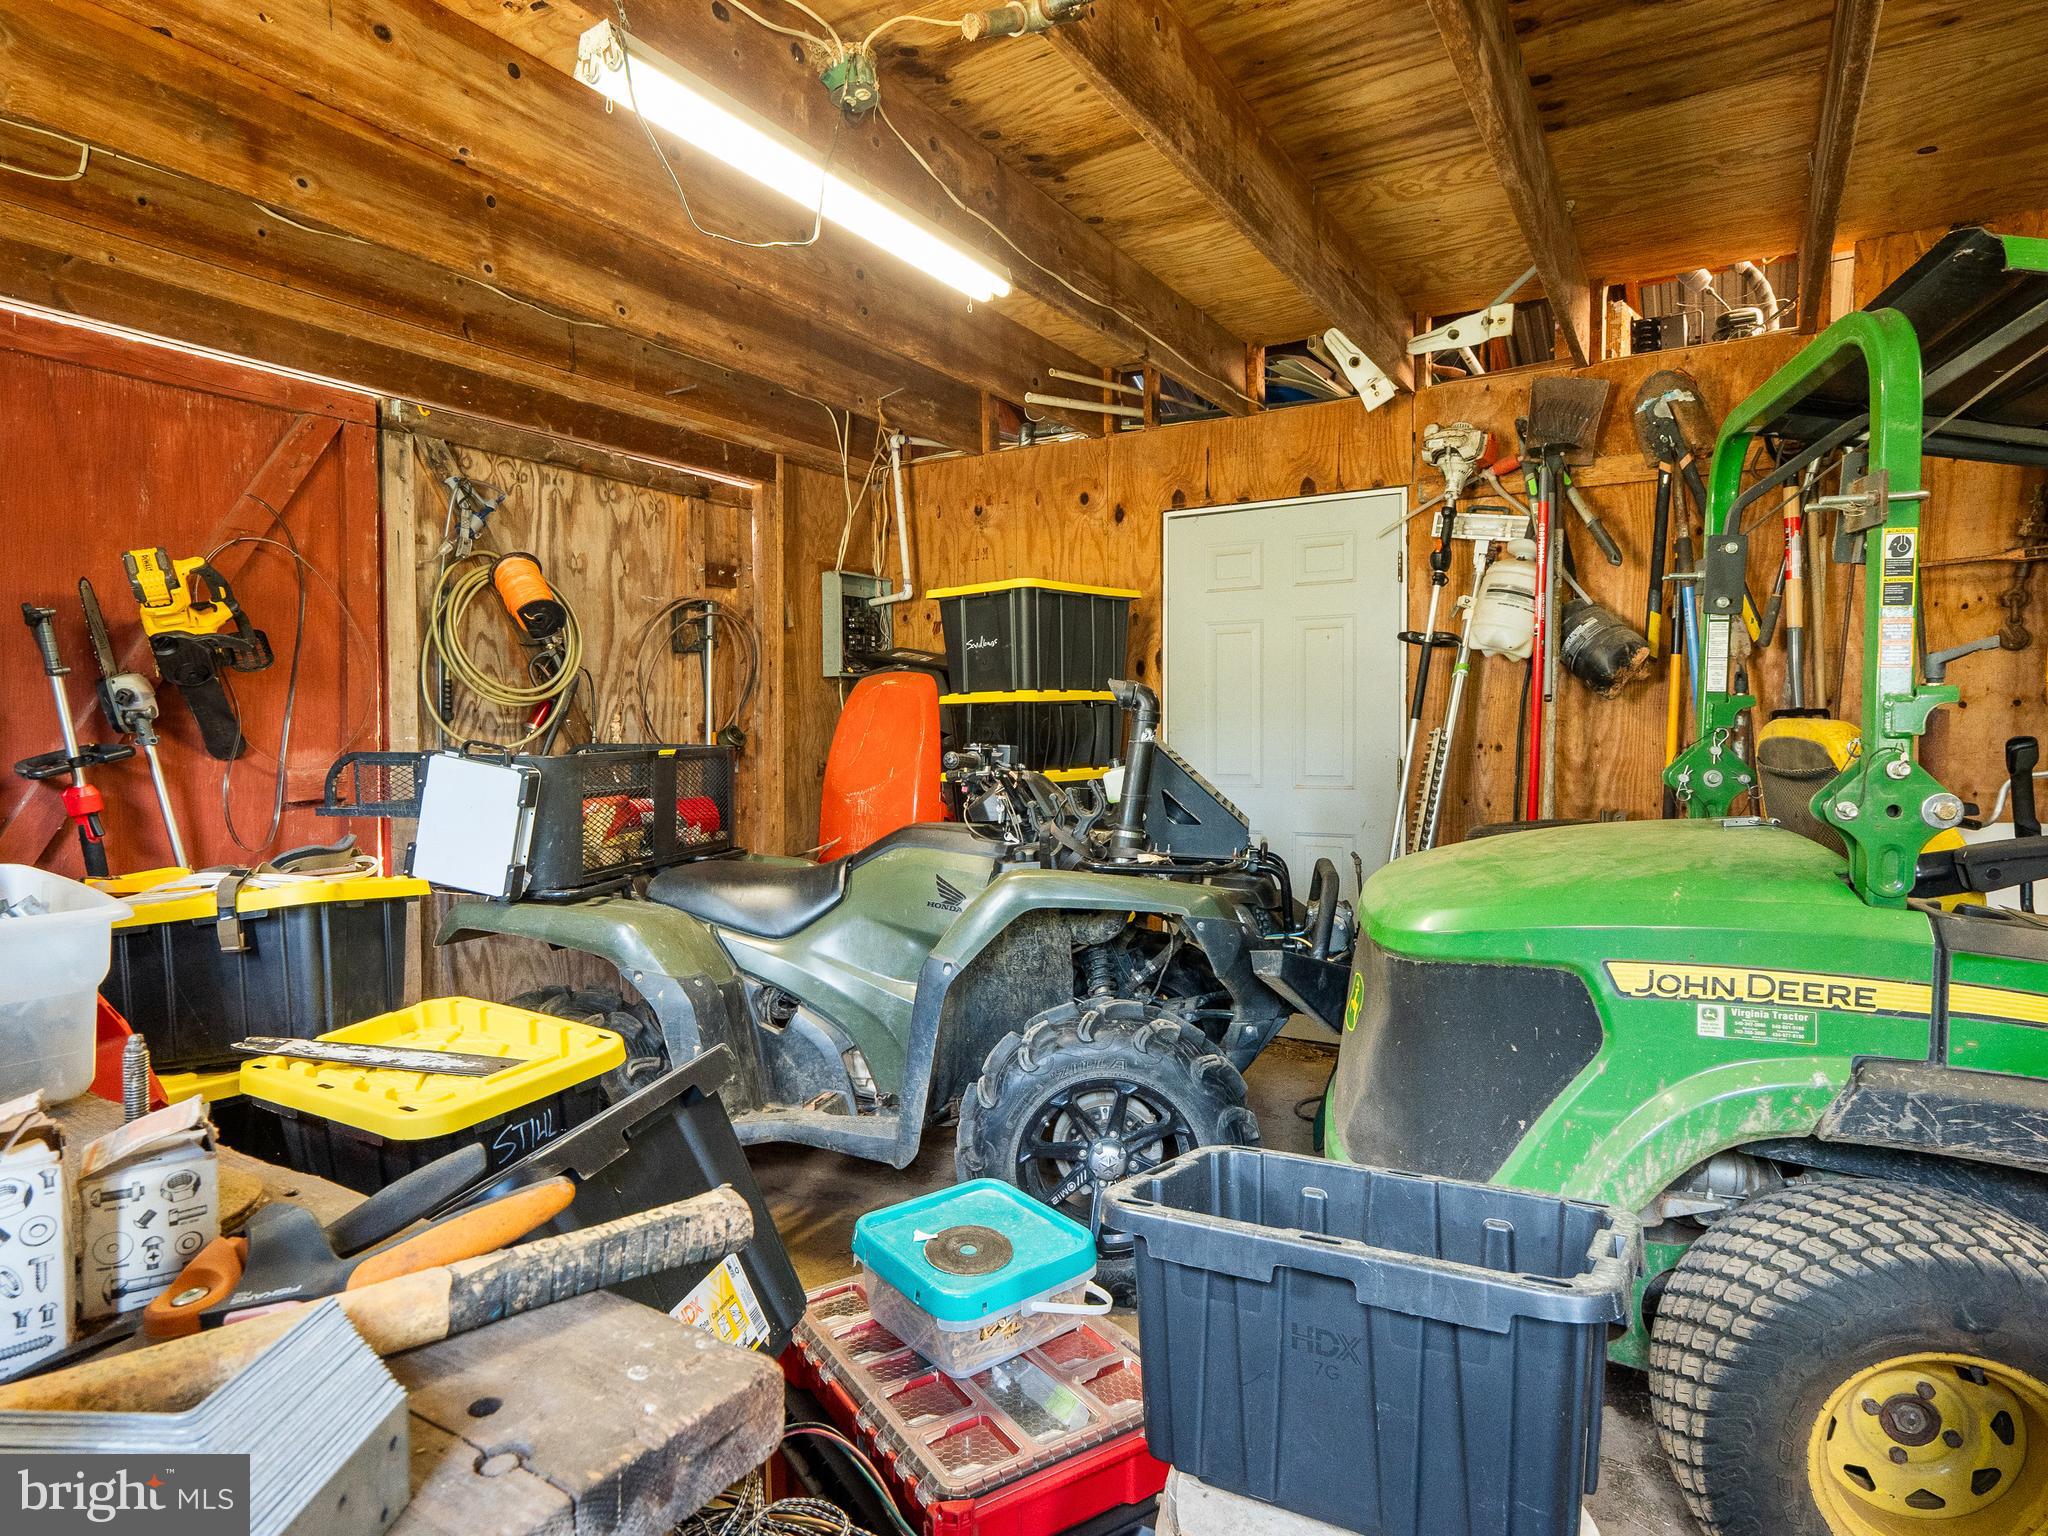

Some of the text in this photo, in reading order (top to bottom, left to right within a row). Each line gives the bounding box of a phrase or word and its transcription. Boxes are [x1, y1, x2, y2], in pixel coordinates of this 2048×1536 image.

[927, 900, 963, 913] HONDA
[1634, 969, 1877, 1009] JOHN DEERE
[1731, 1008, 1809, 1022] Virginia Tractor
[1056, 1058, 1127, 1081] ZILLA
[1291, 1322, 1362, 1367] HDX
[1313, 1361, 1340, 1380] 7G
